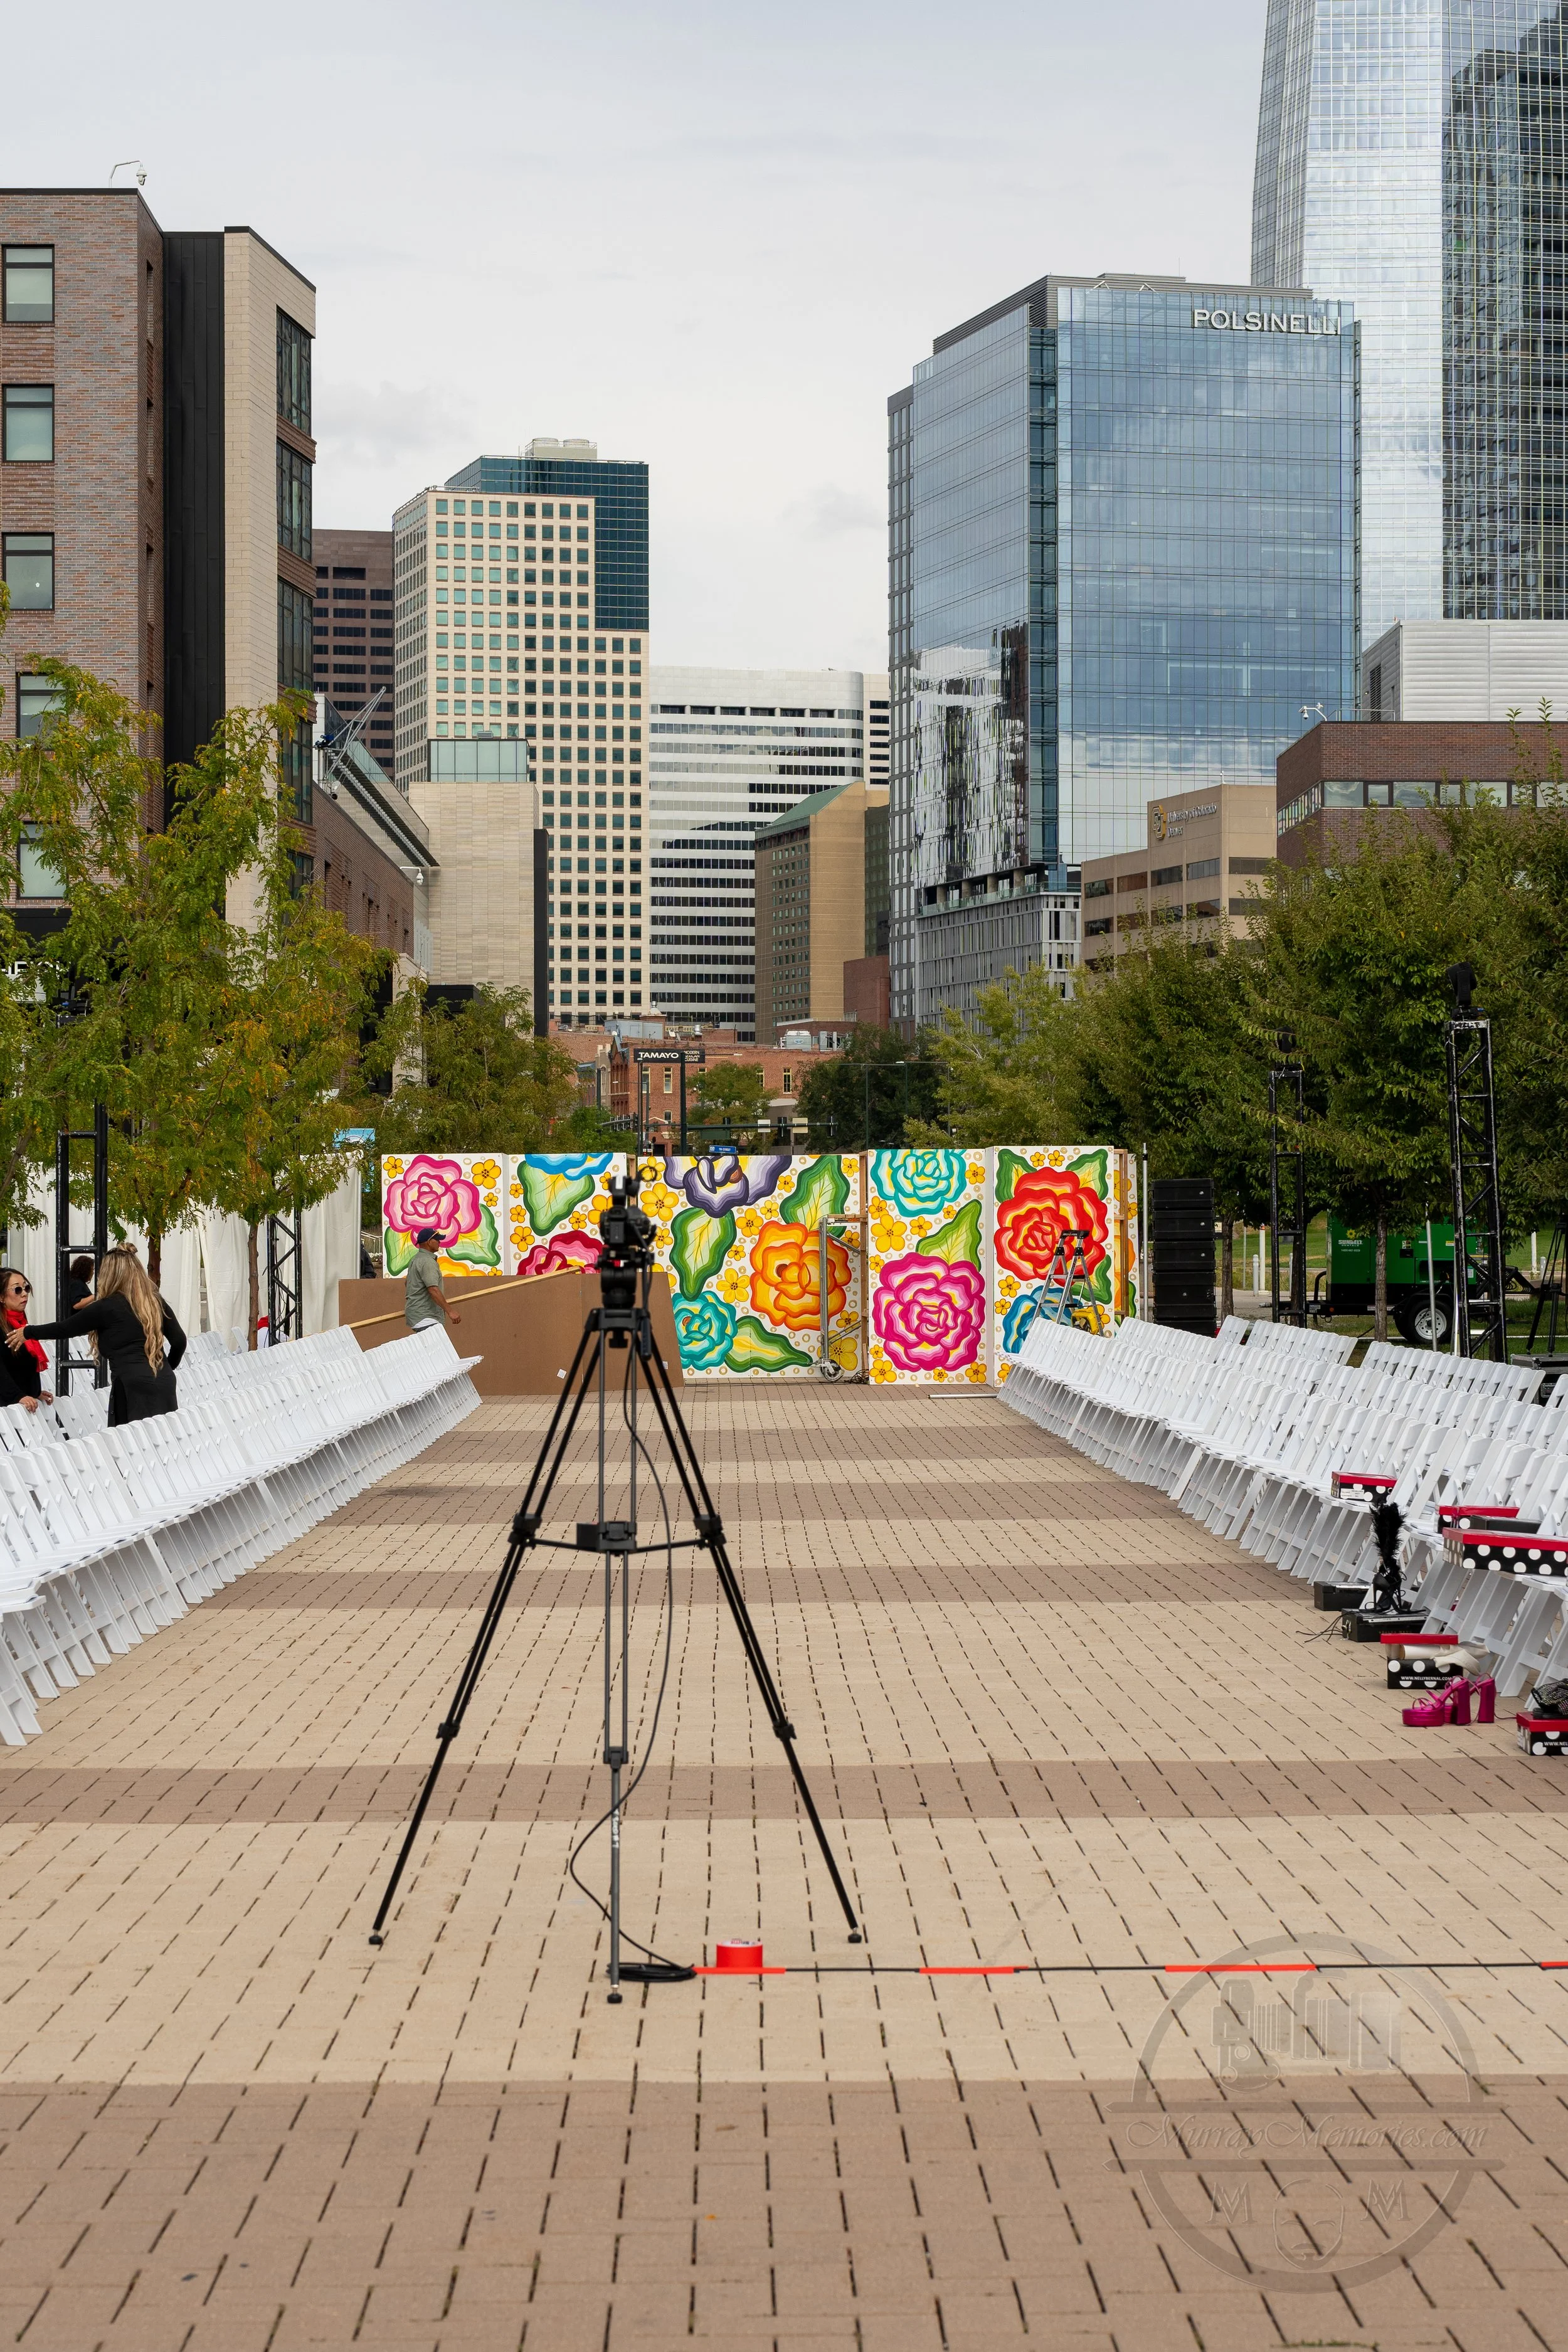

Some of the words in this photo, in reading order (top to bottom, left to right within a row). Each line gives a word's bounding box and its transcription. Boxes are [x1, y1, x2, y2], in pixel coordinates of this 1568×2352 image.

[1194, 309, 1341, 335] POLSINELLI
[1167, 810, 1189, 824] University
[1195, 803, 1217, 817] Colorado
[1167, 827, 1184, 837] Denver
